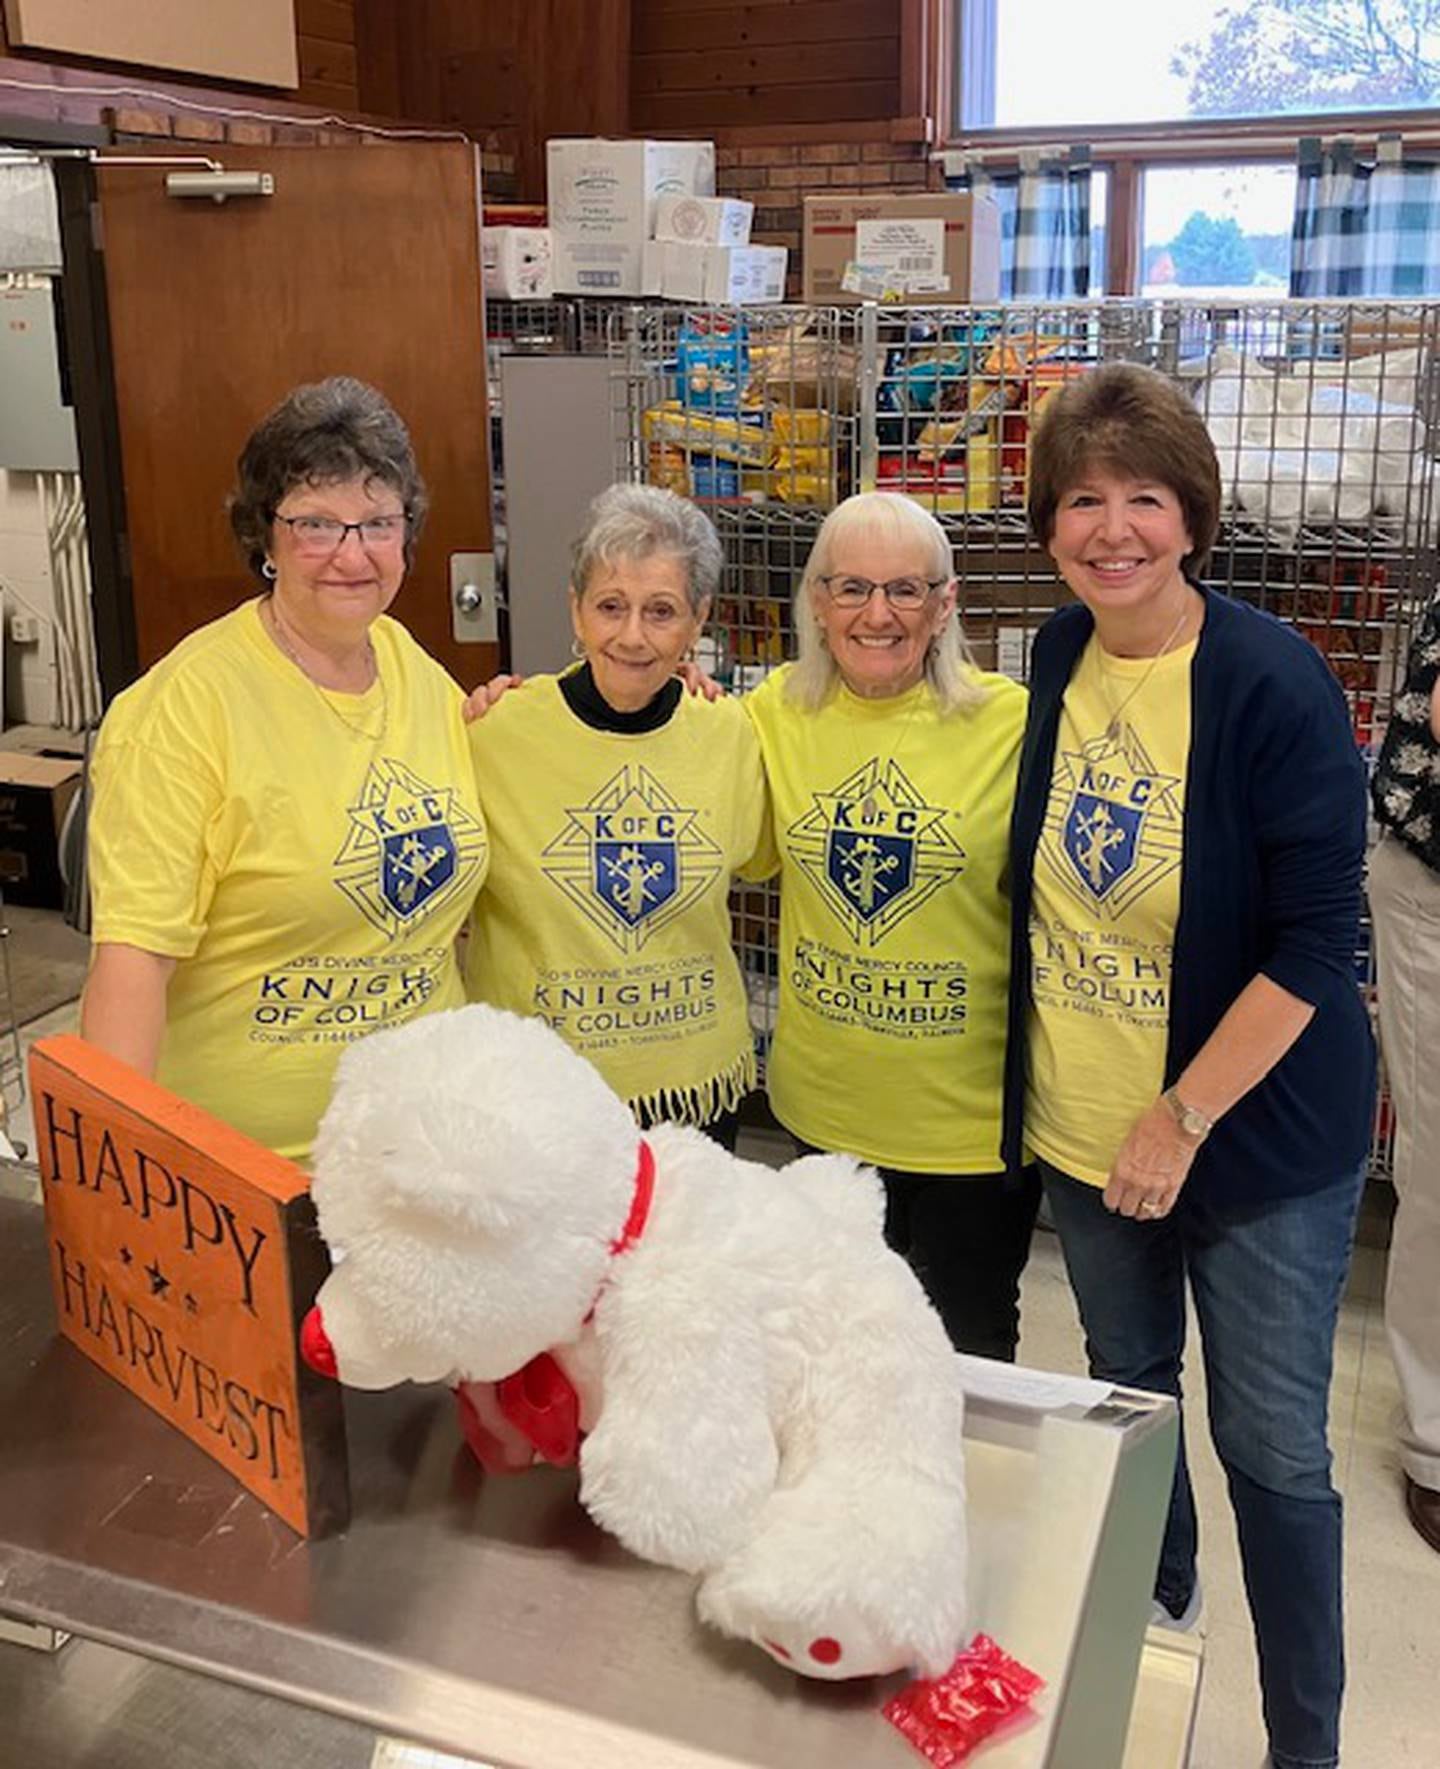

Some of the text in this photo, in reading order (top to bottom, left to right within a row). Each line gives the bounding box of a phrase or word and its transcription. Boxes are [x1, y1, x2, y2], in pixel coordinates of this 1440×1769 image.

[1097, 772, 1126, 792] OF
[1129, 778, 1151, 805] C
[371, 798, 443, 833] K OF C
[595, 815, 675, 838] K OF C
[834, 802, 854, 827] K
[895, 811, 917, 834] C
[323, 955, 374, 968] DIVINE
[574, 968, 620, 980] DIVINE
[624, 963, 666, 977] MERCY
[795, 945, 967, 999] KNIGHTS
[855, 956, 901, 972] MERCY
[902, 960, 967, 972] COUNCIL
[533, 968, 715, 1008] KNIGHTS
[254, 1005, 305, 1025] OF
[576, 995, 717, 1033] COLUMBUS
[816, 988, 967, 1023] COLUMBUS
[248, 1029, 306, 1043] COUNCIL
[42, 1091, 267, 1317] HAPPY
[55, 1239, 291, 1480] HARVEST
